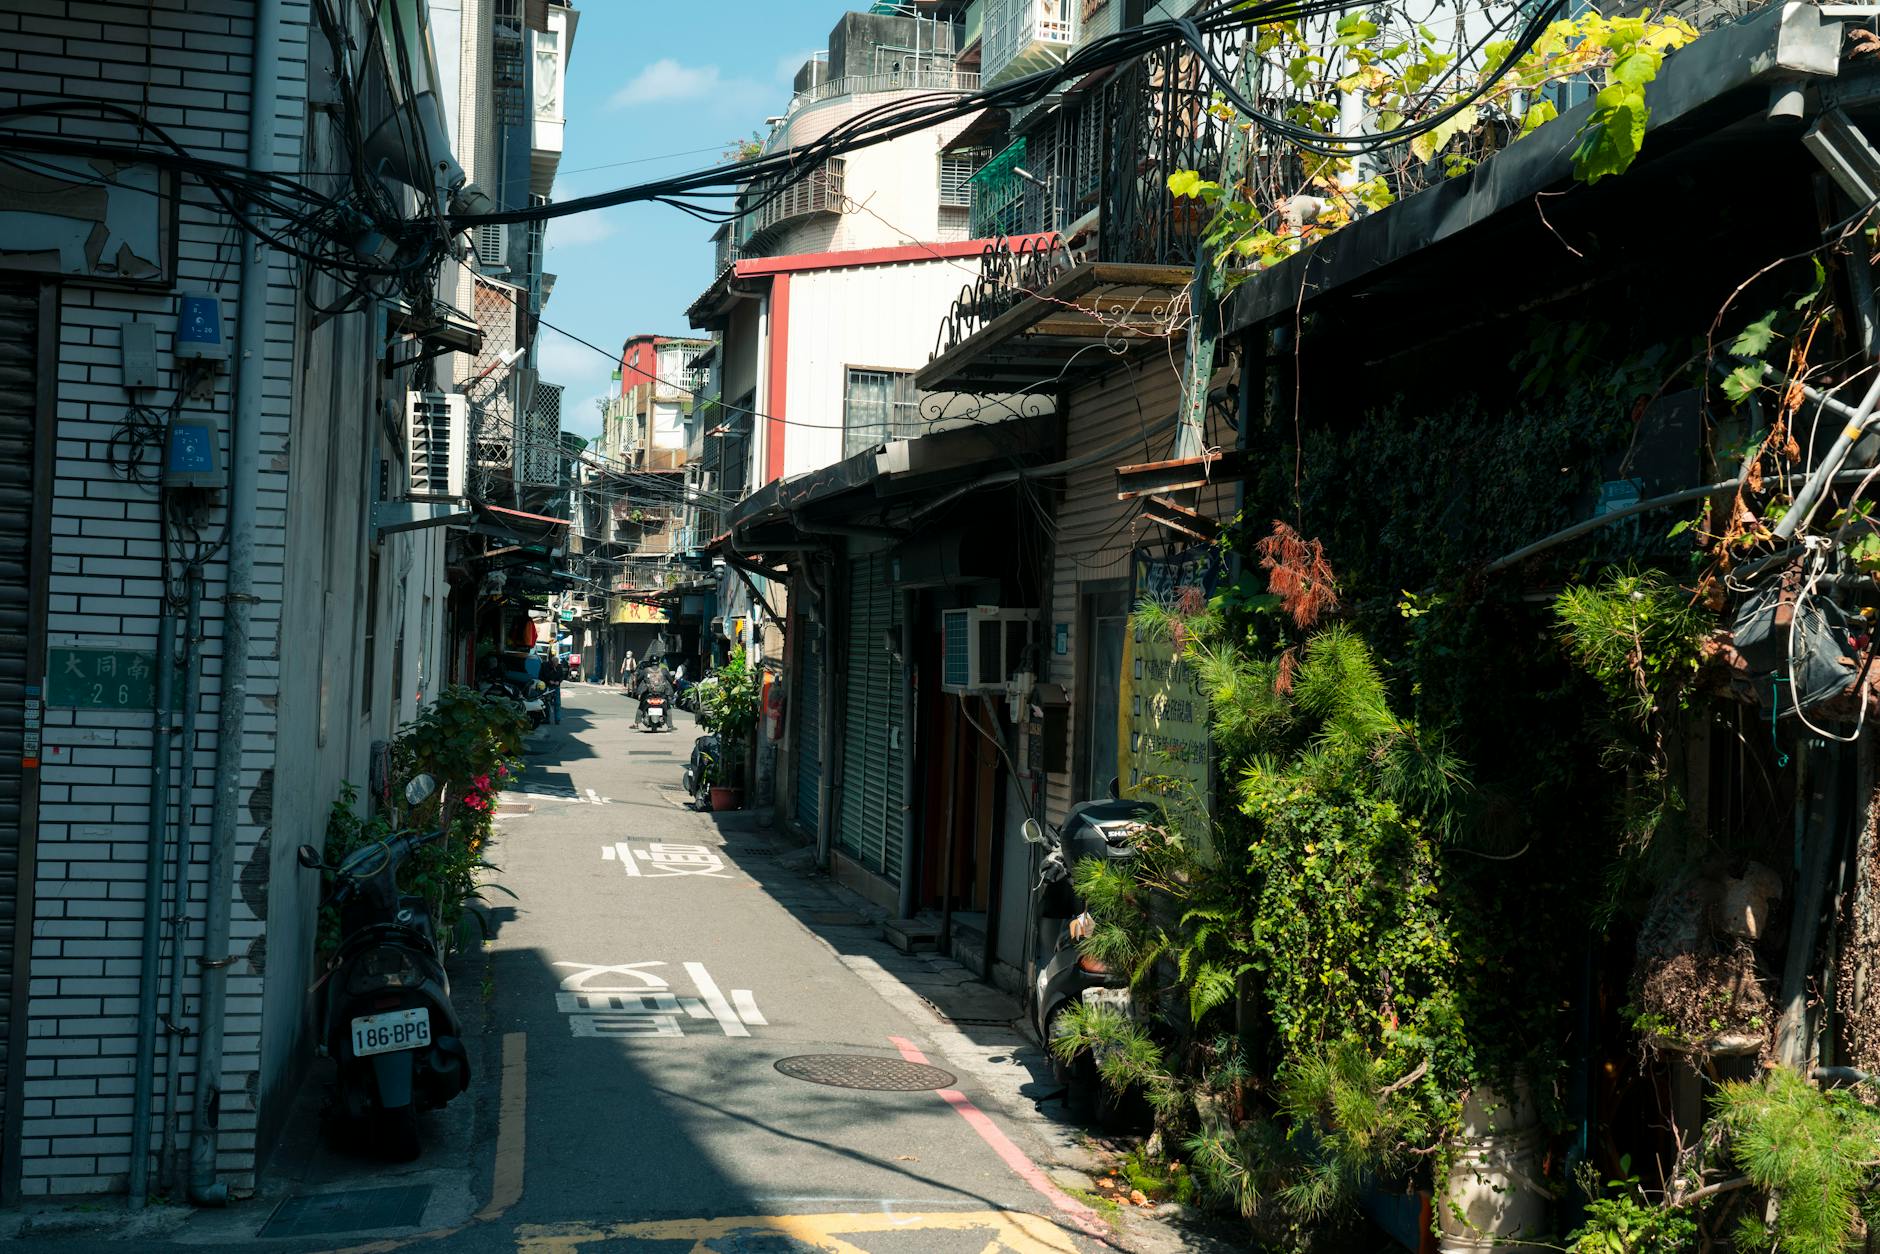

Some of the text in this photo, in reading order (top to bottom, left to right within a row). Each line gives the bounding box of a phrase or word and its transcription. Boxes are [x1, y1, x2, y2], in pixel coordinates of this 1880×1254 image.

[64, 652, 181, 679] 大同南
[600, 841, 735, 878] 慢
[552, 960, 768, 1038] 慢
